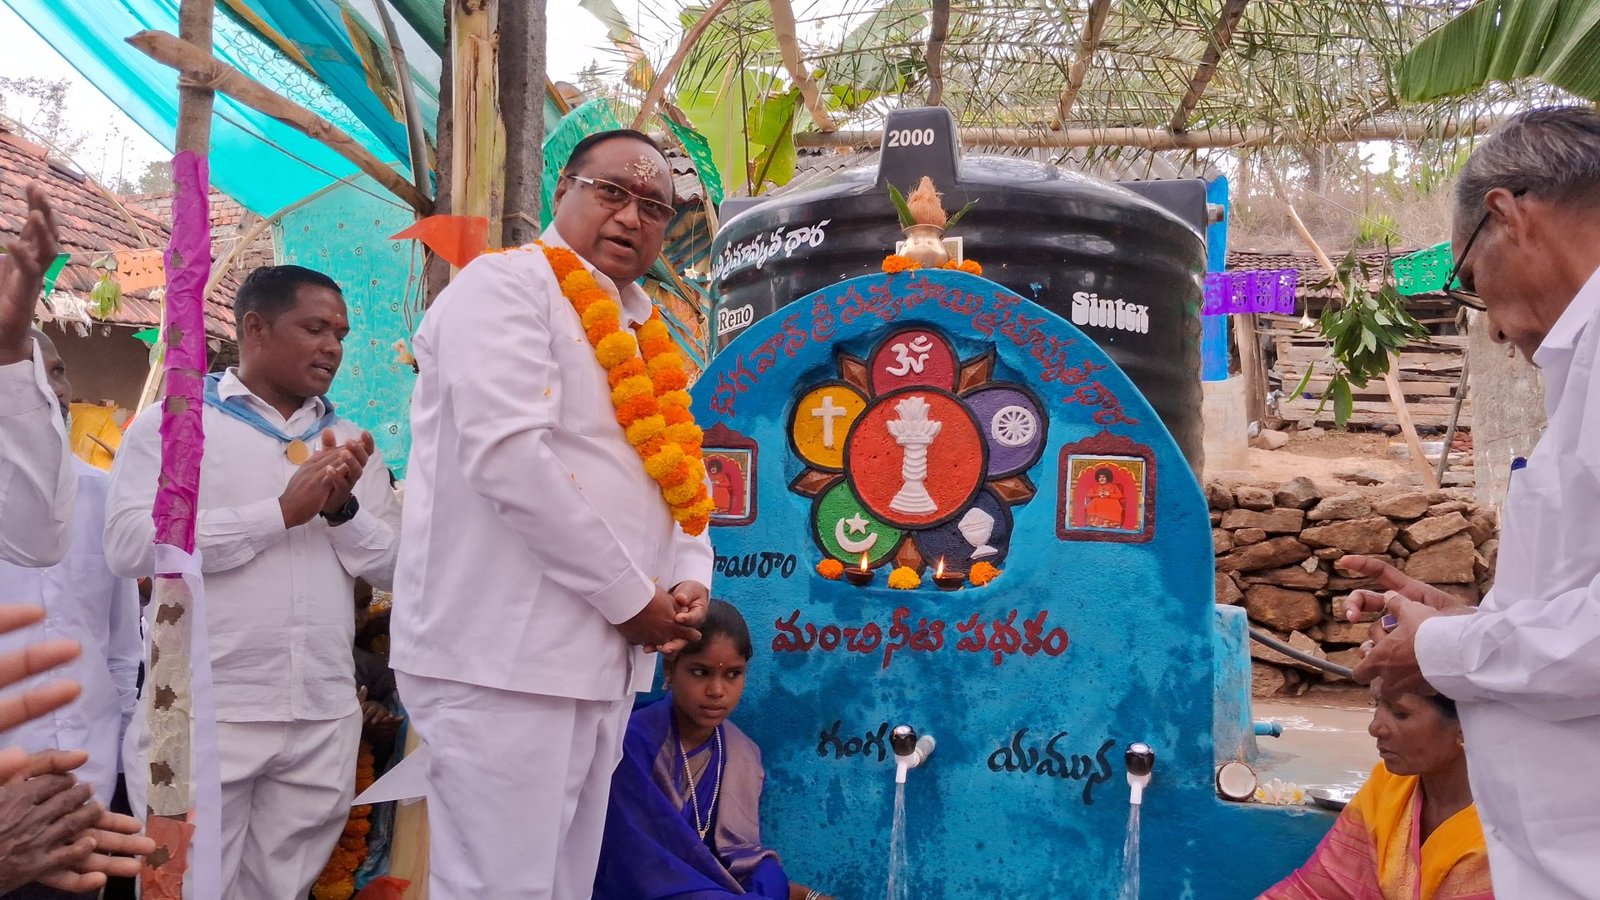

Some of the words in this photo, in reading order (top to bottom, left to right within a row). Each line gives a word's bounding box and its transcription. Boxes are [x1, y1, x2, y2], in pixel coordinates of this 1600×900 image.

[887, 128, 935, 148] 2000
[718, 304, 752, 333] Reno
[1072, 291, 1149, 334] Sintex
[709, 311, 808, 418] భగవాన్
[811, 294, 838, 343] శ్రీ
[816, 719, 889, 763] గంగ
[987, 727, 1116, 806] యమున
